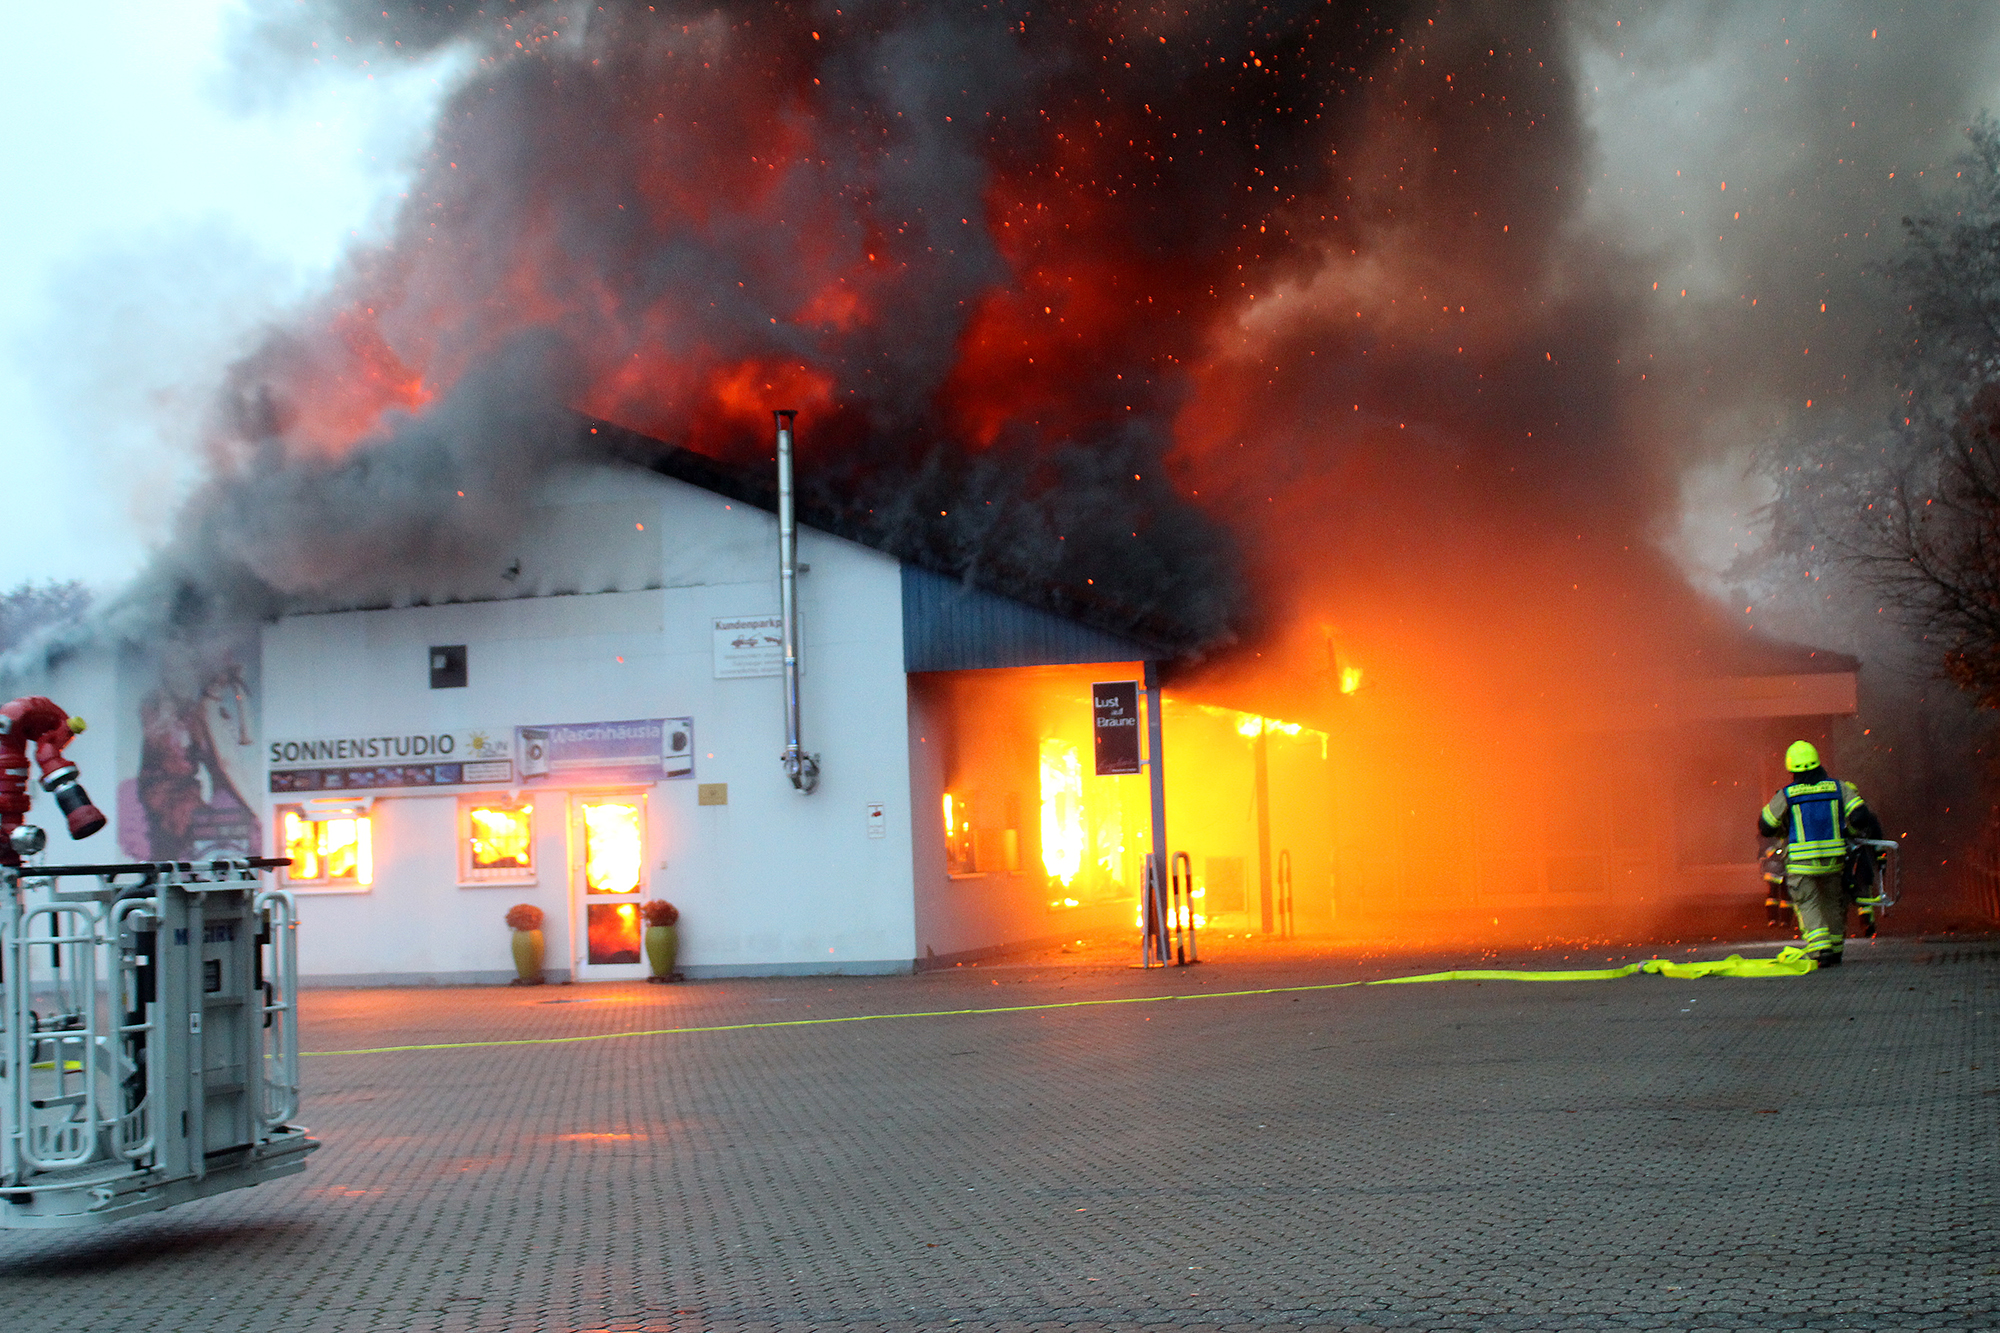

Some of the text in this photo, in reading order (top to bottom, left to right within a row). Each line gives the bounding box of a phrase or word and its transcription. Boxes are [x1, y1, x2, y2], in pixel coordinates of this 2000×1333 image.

[716, 619, 782, 630] Kundenparkp
[1095, 697, 1119, 708] Lust
[1097, 717, 1136, 727] Bräune
[270, 734, 455, 762] SONNENSTUDIO
